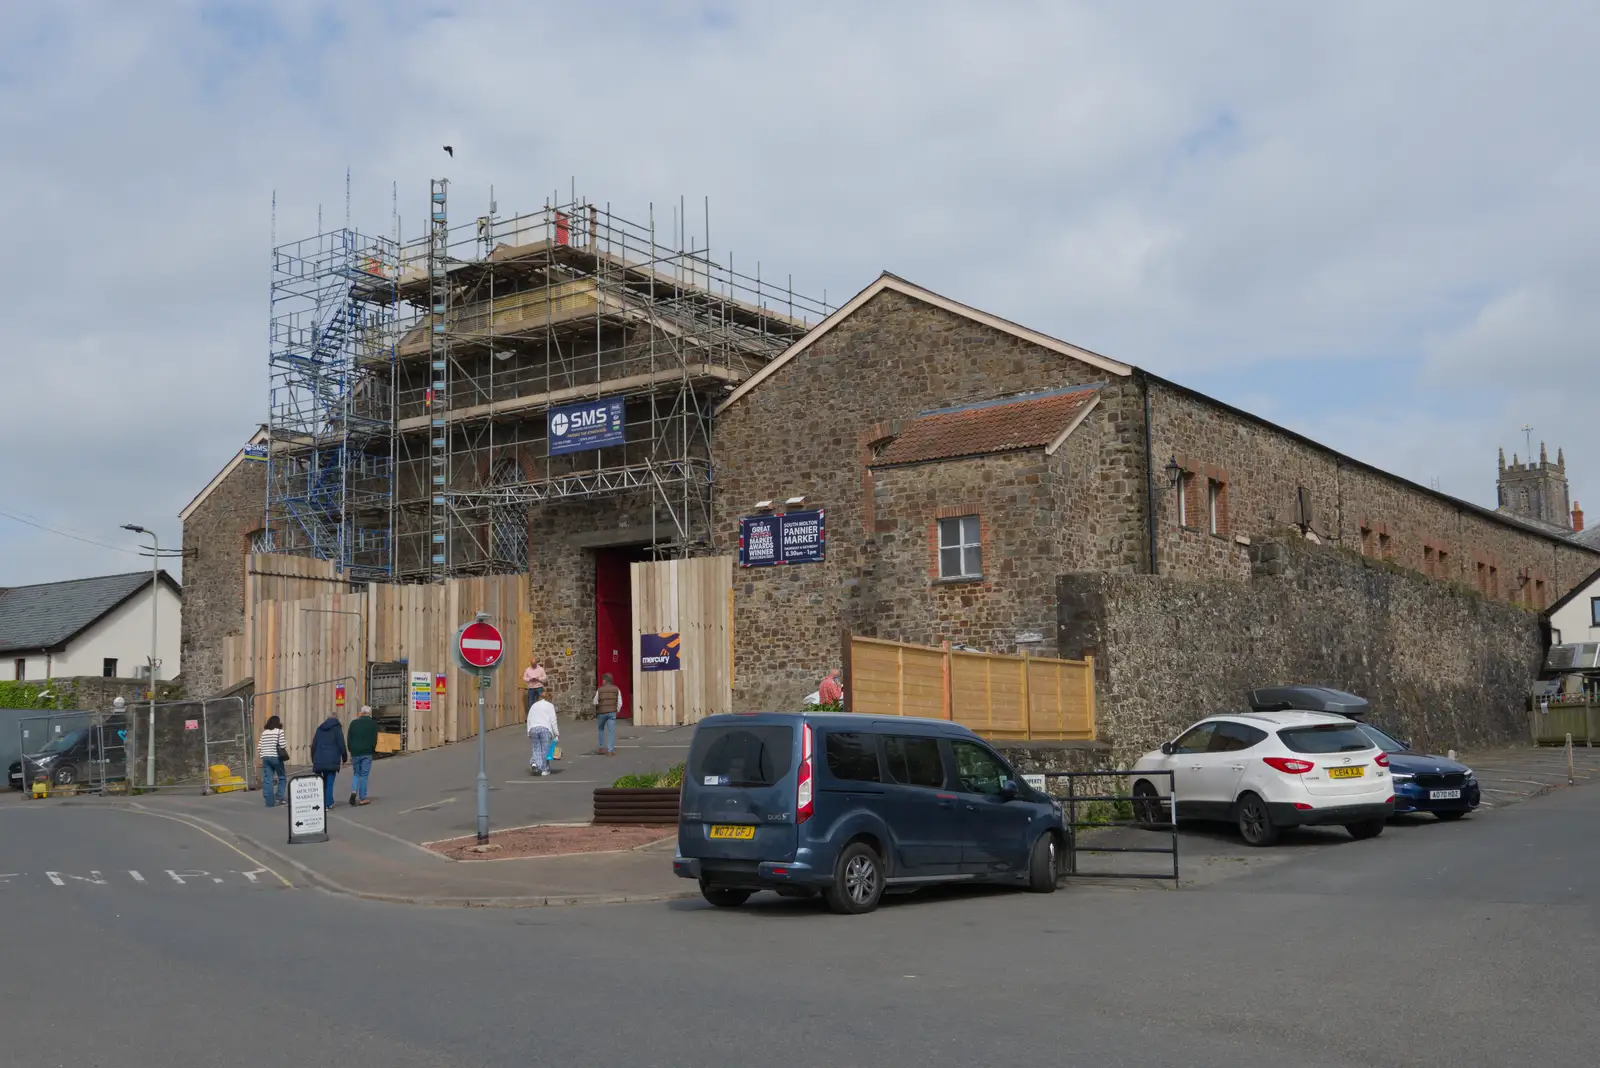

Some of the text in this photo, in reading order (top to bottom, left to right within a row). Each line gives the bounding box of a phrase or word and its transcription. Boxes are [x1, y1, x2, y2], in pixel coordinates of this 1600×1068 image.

[570, 407, 607, 428] SMS
[252, 444, 268, 452] SMS
[751, 525, 770, 533] GREAT
[784, 525, 818, 536] PANNIER
[749, 536, 773, 545] MARKET
[784, 533, 818, 545] MARKET
[749, 542, 774, 550] AWARDS
[748, 549, 774, 557] WINNER
[642, 656, 669, 664] mercury
[1334, 768, 1349, 777] CE14
